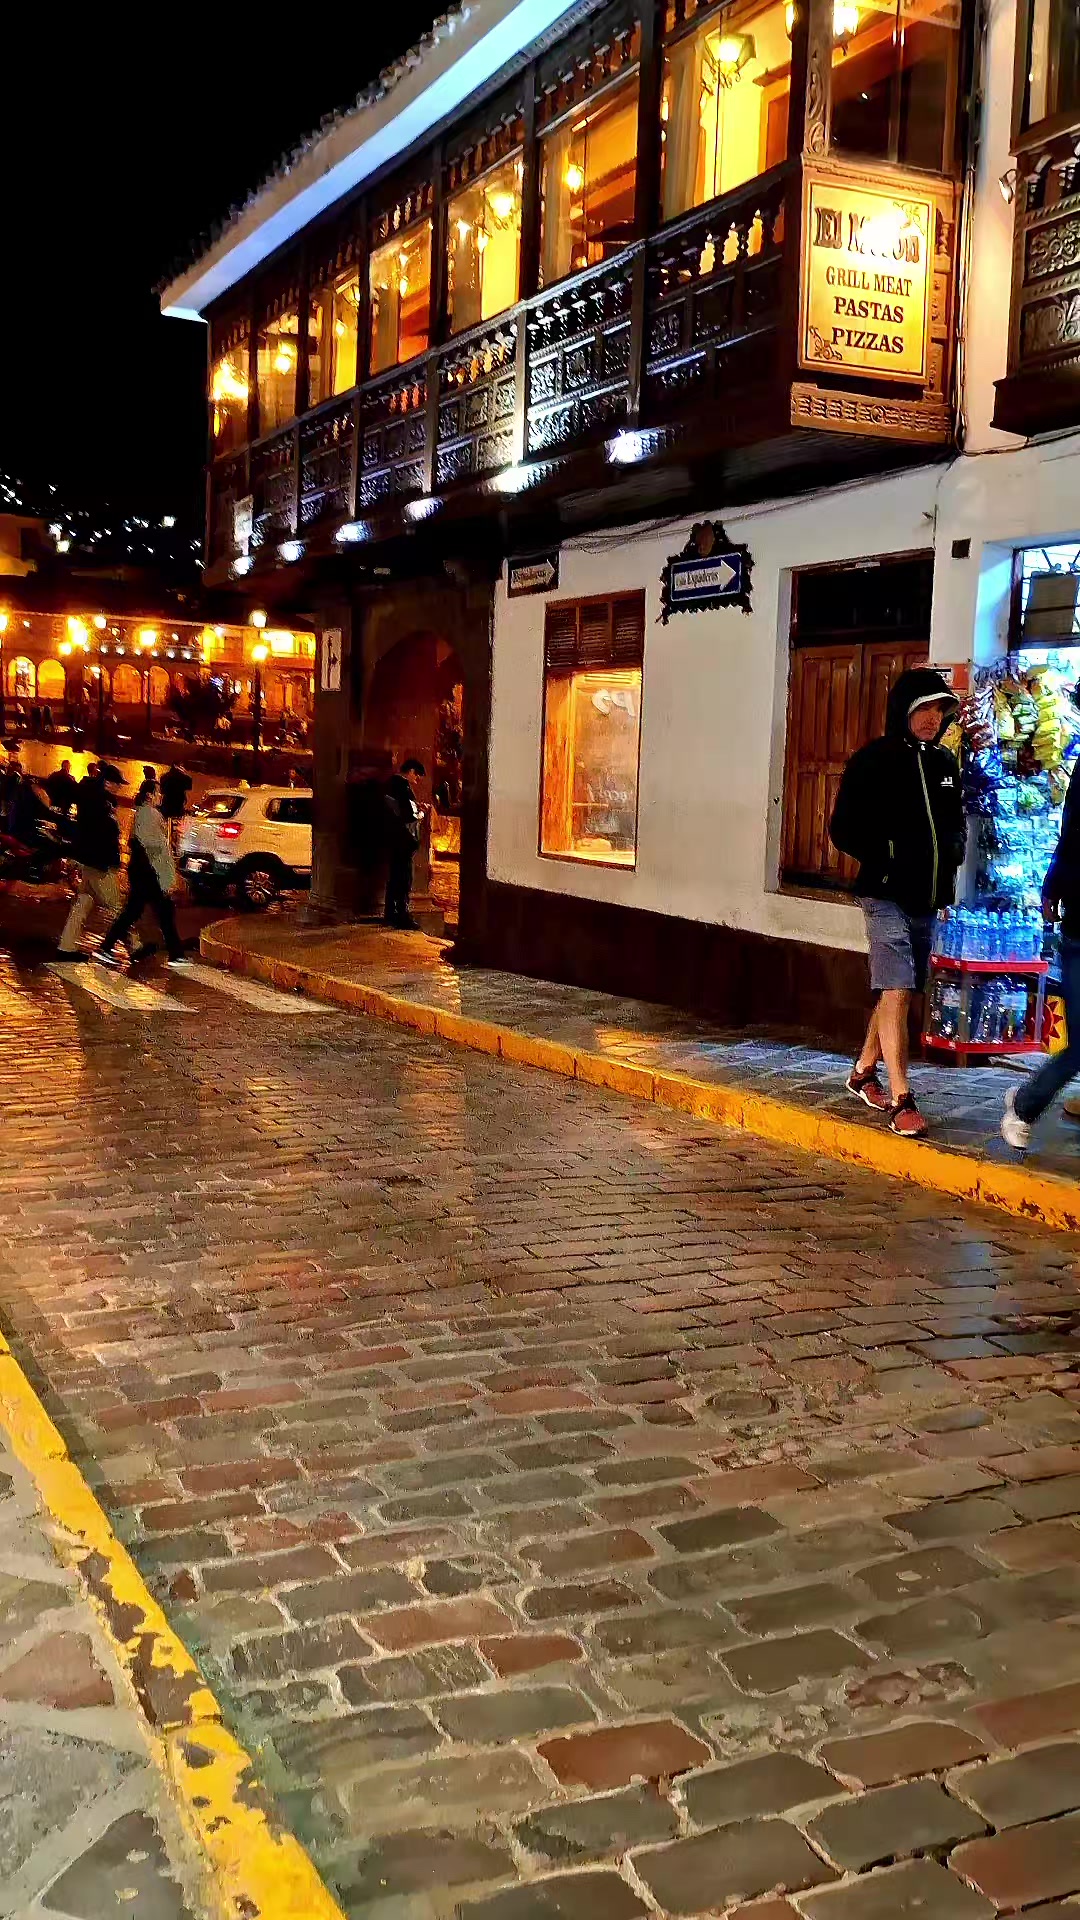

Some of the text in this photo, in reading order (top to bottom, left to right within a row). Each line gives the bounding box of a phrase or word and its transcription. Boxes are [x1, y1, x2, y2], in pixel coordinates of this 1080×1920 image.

[826, 266, 912, 296] GRILL MEAT
[834, 296, 904, 323] PASTAS
[832, 327, 904, 354] PIZZAS
